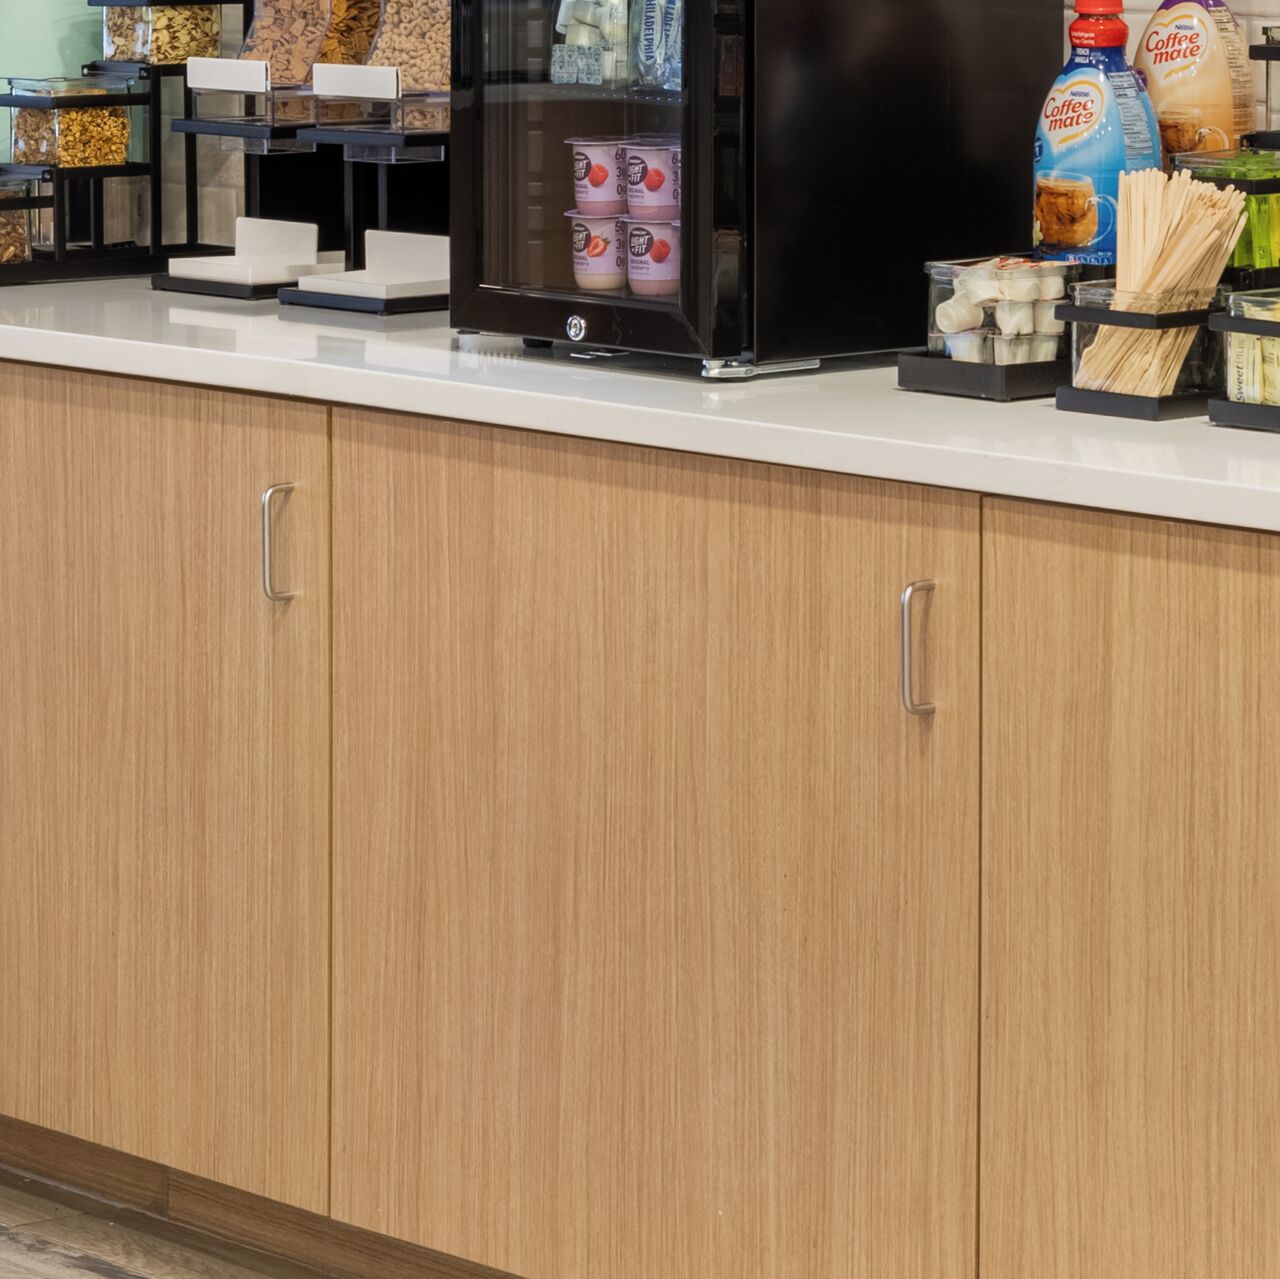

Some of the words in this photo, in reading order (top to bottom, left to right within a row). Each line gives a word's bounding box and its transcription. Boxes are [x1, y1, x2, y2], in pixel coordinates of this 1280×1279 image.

[1146, 31, 1200, 53] Coffee
[1153, 45, 1200, 65] mate
[1044, 98, 1094, 119] Coffee
[1048, 112, 1094, 132] mate
